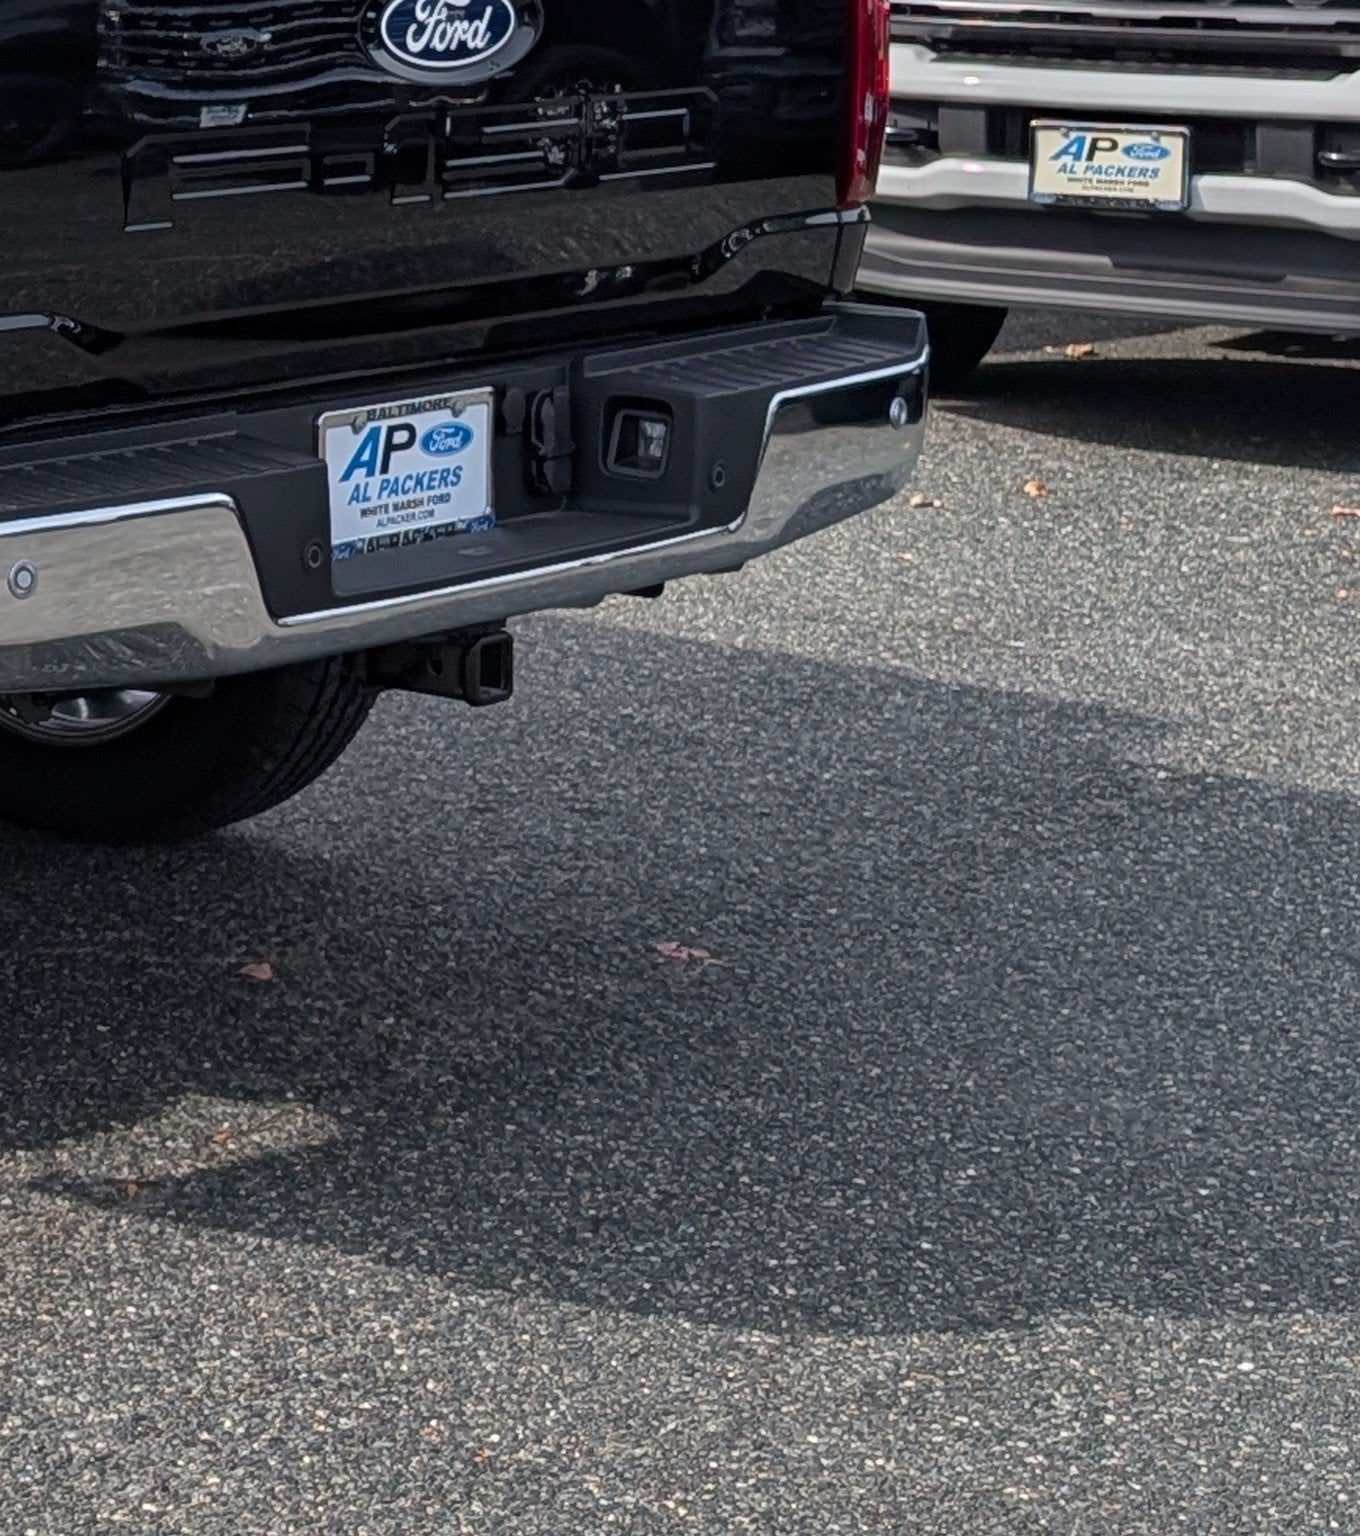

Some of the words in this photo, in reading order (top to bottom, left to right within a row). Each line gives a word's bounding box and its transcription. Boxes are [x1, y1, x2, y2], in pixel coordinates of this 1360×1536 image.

[1049, 135, 1119, 162] AP
[1057, 163, 1077, 175] AL
[1083, 163, 1161, 179] PACKERS
[366, 397, 452, 421] BALTIMORE
[338, 422, 416, 483] AP
[430, 427, 464, 452] Ford
[347, 483, 371, 505] AL
[377, 465, 463, 499] PACKERS
[360, 500, 390, 518] WHITE
[392, 496, 424, 513] MARSH
[427, 492, 451, 506] FORD
